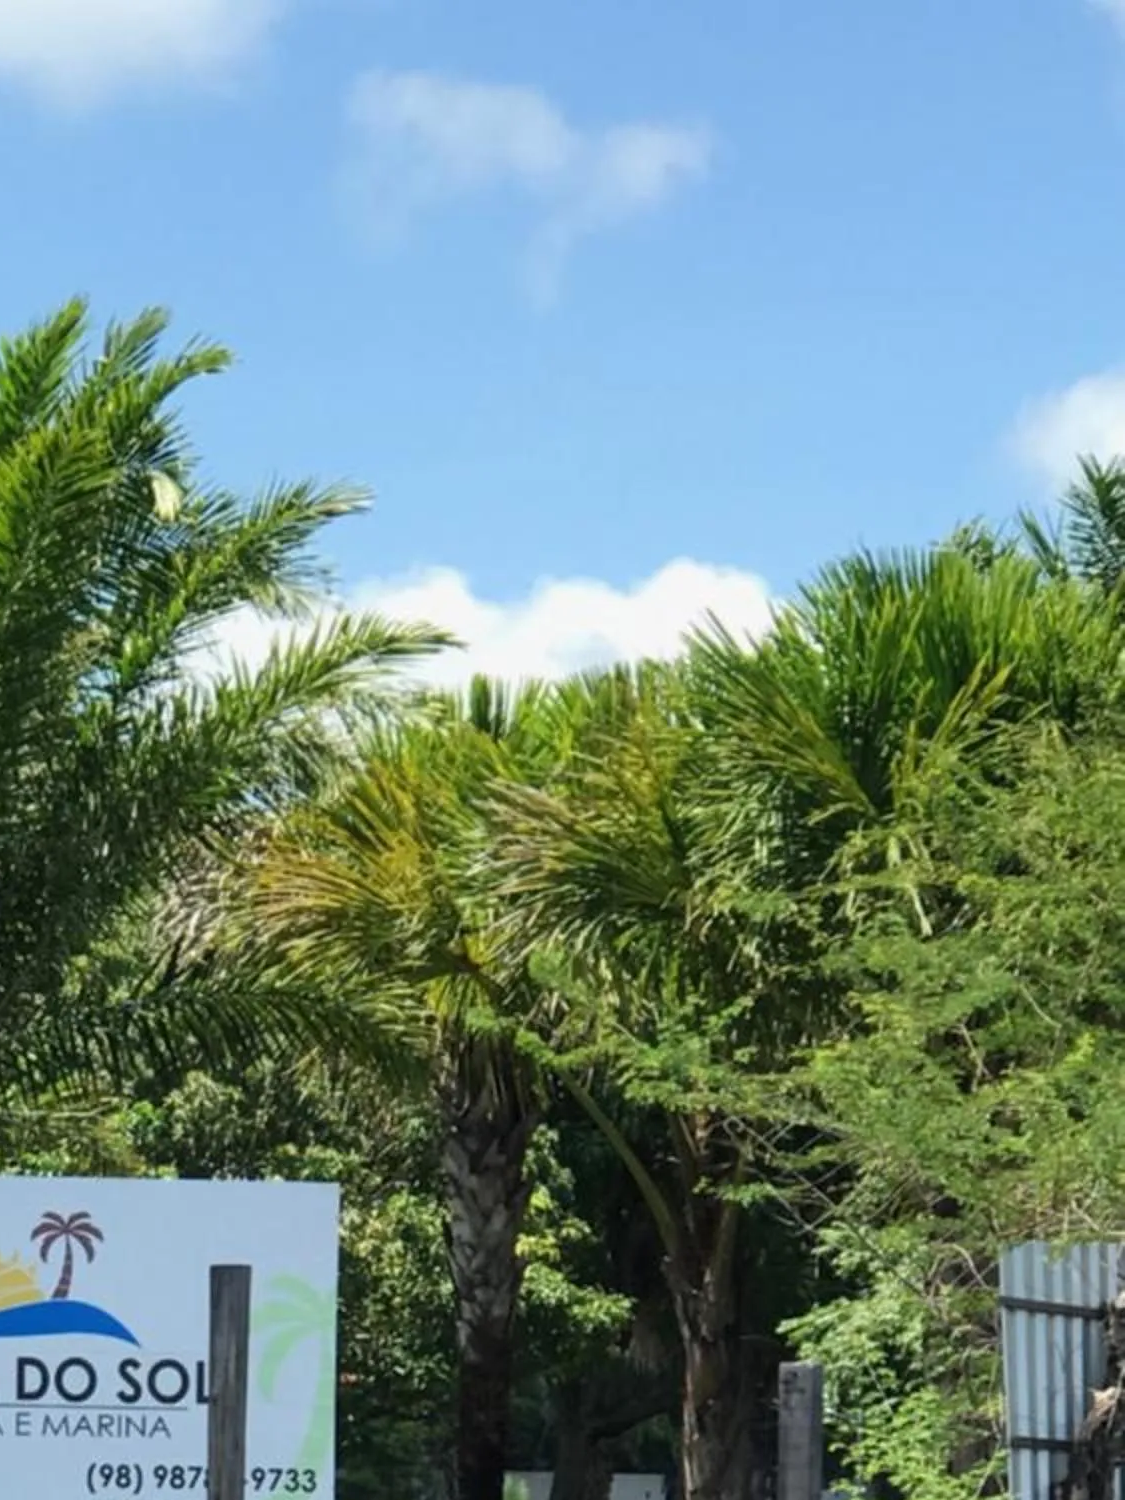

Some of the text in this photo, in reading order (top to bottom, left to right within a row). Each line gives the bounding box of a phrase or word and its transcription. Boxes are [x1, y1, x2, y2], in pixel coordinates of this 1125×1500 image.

[15, 1355, 98, 1403] DO
[115, 1357, 211, 1405] SOL
[15, 1411, 31, 1437] E
[41, 1412, 173, 1439] MARINA
[86, 1462, 144, 1494] (98)
